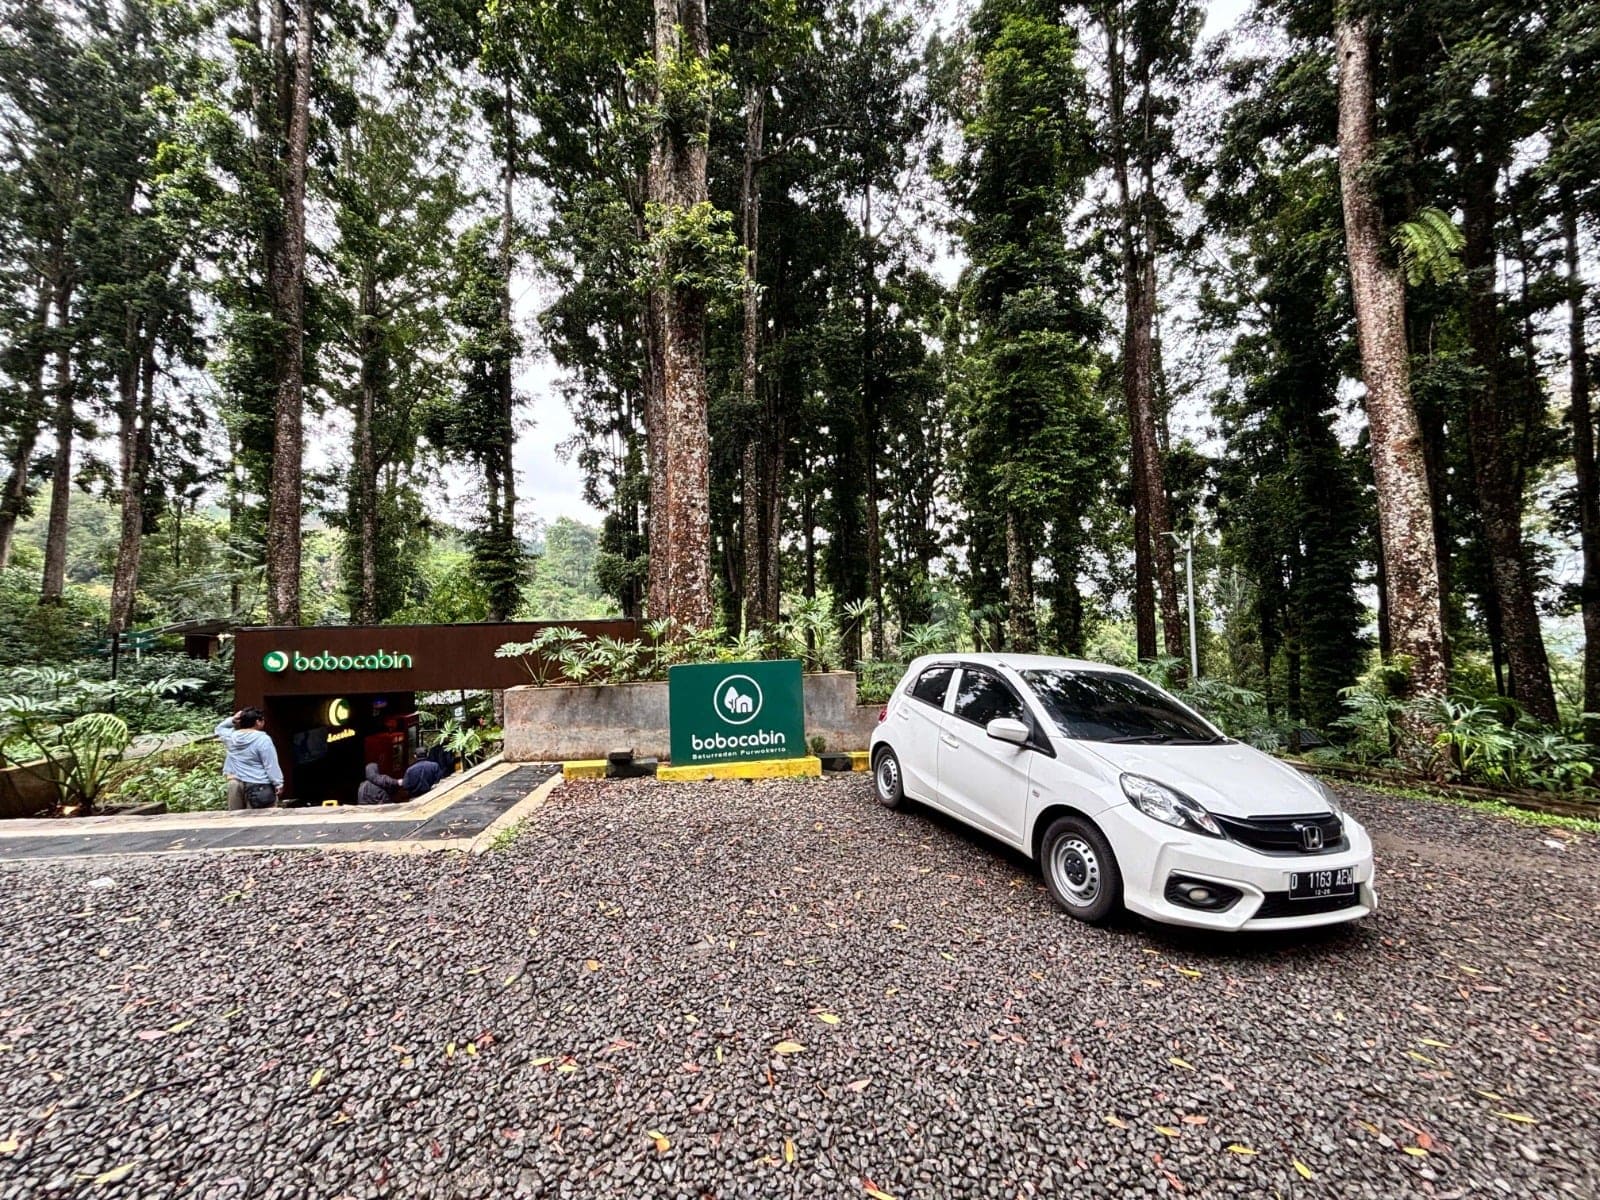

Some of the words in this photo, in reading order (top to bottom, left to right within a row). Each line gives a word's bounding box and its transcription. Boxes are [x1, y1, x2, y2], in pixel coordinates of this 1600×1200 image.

[294, 649, 412, 671] bobocabin
[692, 729, 786, 751] bobocabin
[740, 747, 786, 756] Purwokerto
[1309, 871, 1331, 888] 1163
